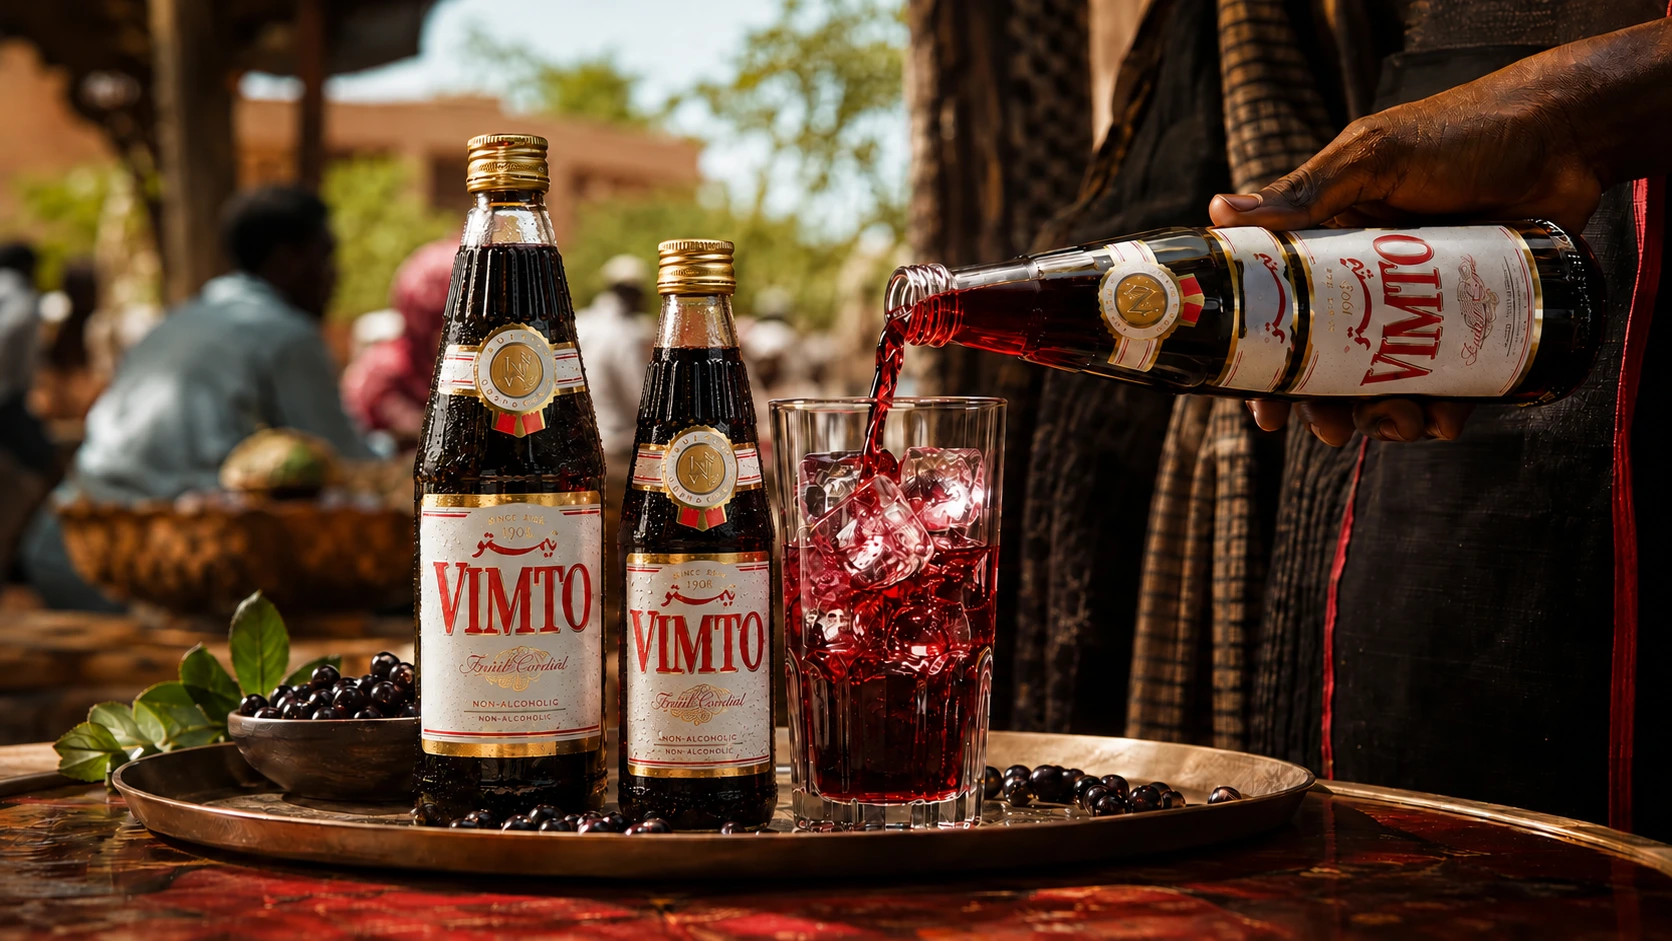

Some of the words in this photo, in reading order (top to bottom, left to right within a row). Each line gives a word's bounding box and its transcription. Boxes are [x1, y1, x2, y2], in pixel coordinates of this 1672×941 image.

[1360, 234, 1444, 386] VIMTO
[433, 561, 592, 636] VIMTO
[630, 609, 764, 675] VIMTO
[472, 698, 559, 708] NON-ALCOHOLIC
[478, 713, 552, 722] NON-ALCOHOLIC
[661, 734, 737, 743] NON-ALCOHOLIC
